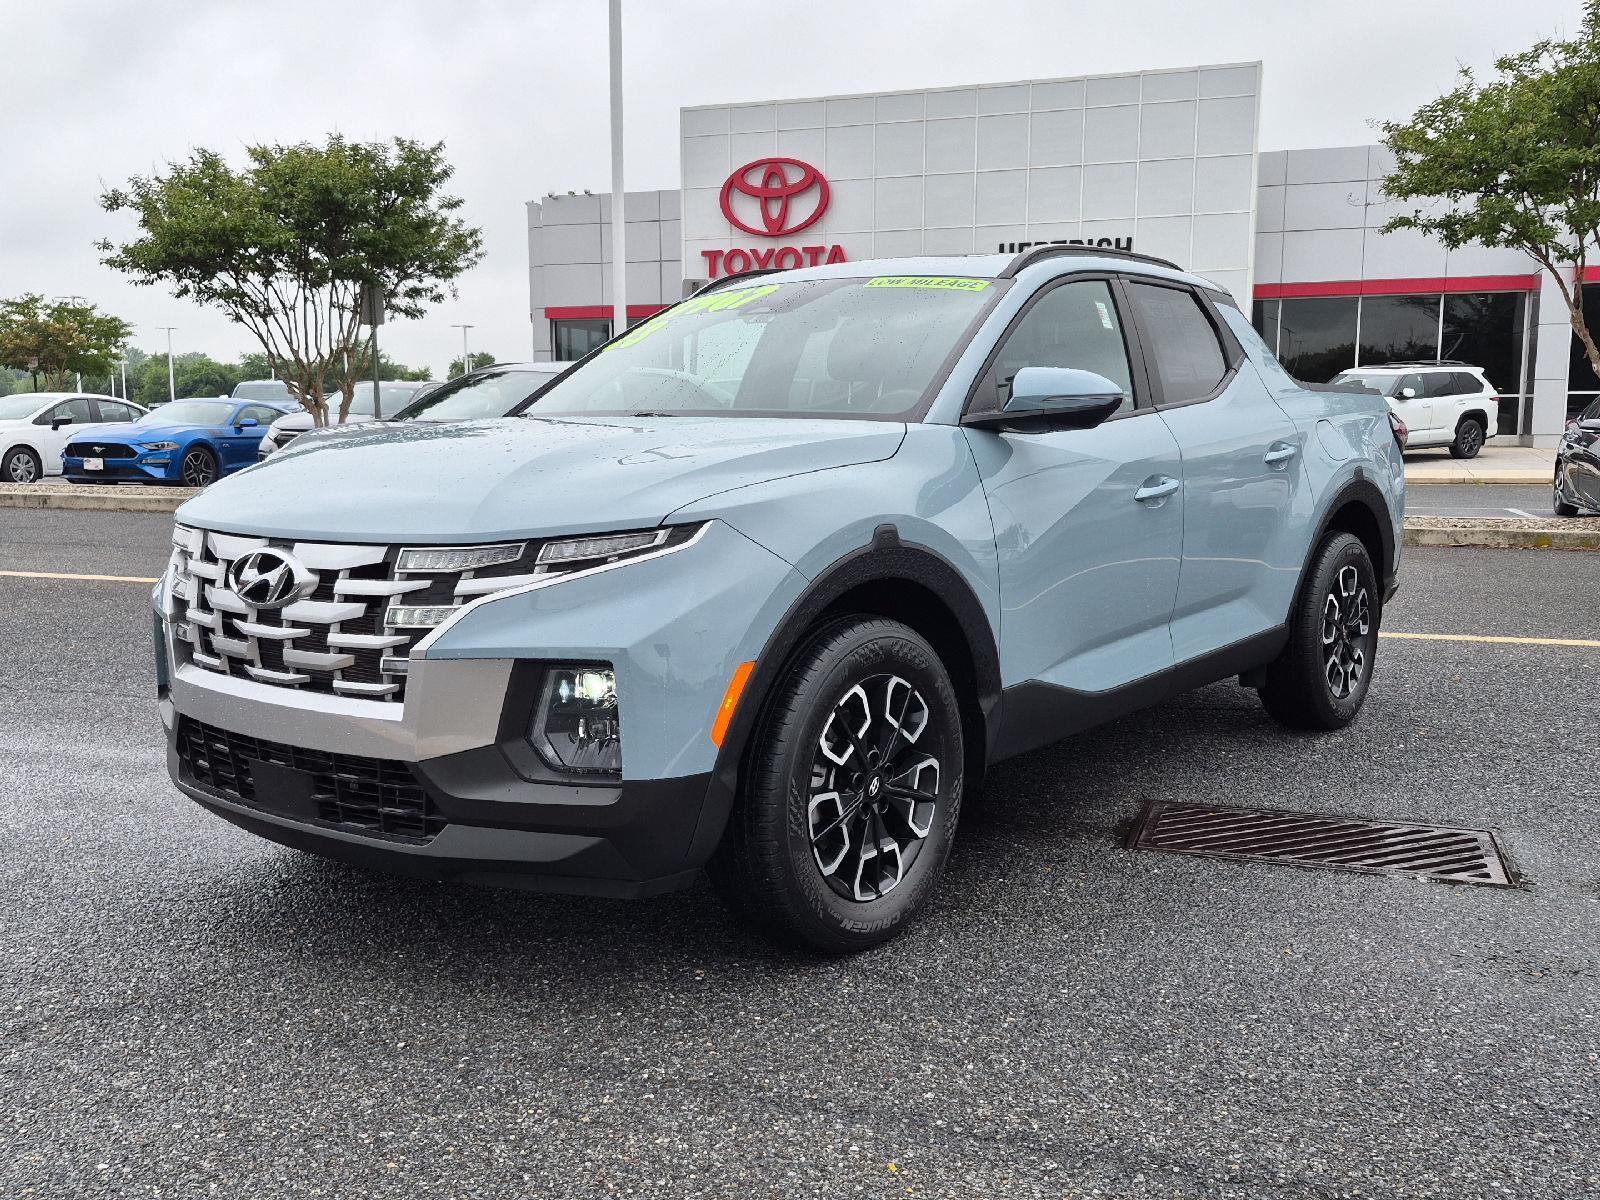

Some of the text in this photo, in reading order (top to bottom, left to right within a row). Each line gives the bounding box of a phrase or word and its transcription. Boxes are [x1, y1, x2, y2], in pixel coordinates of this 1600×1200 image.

[701, 244, 847, 278] TOYOTA
[869, 278, 984, 289] LOW MILEAGE
